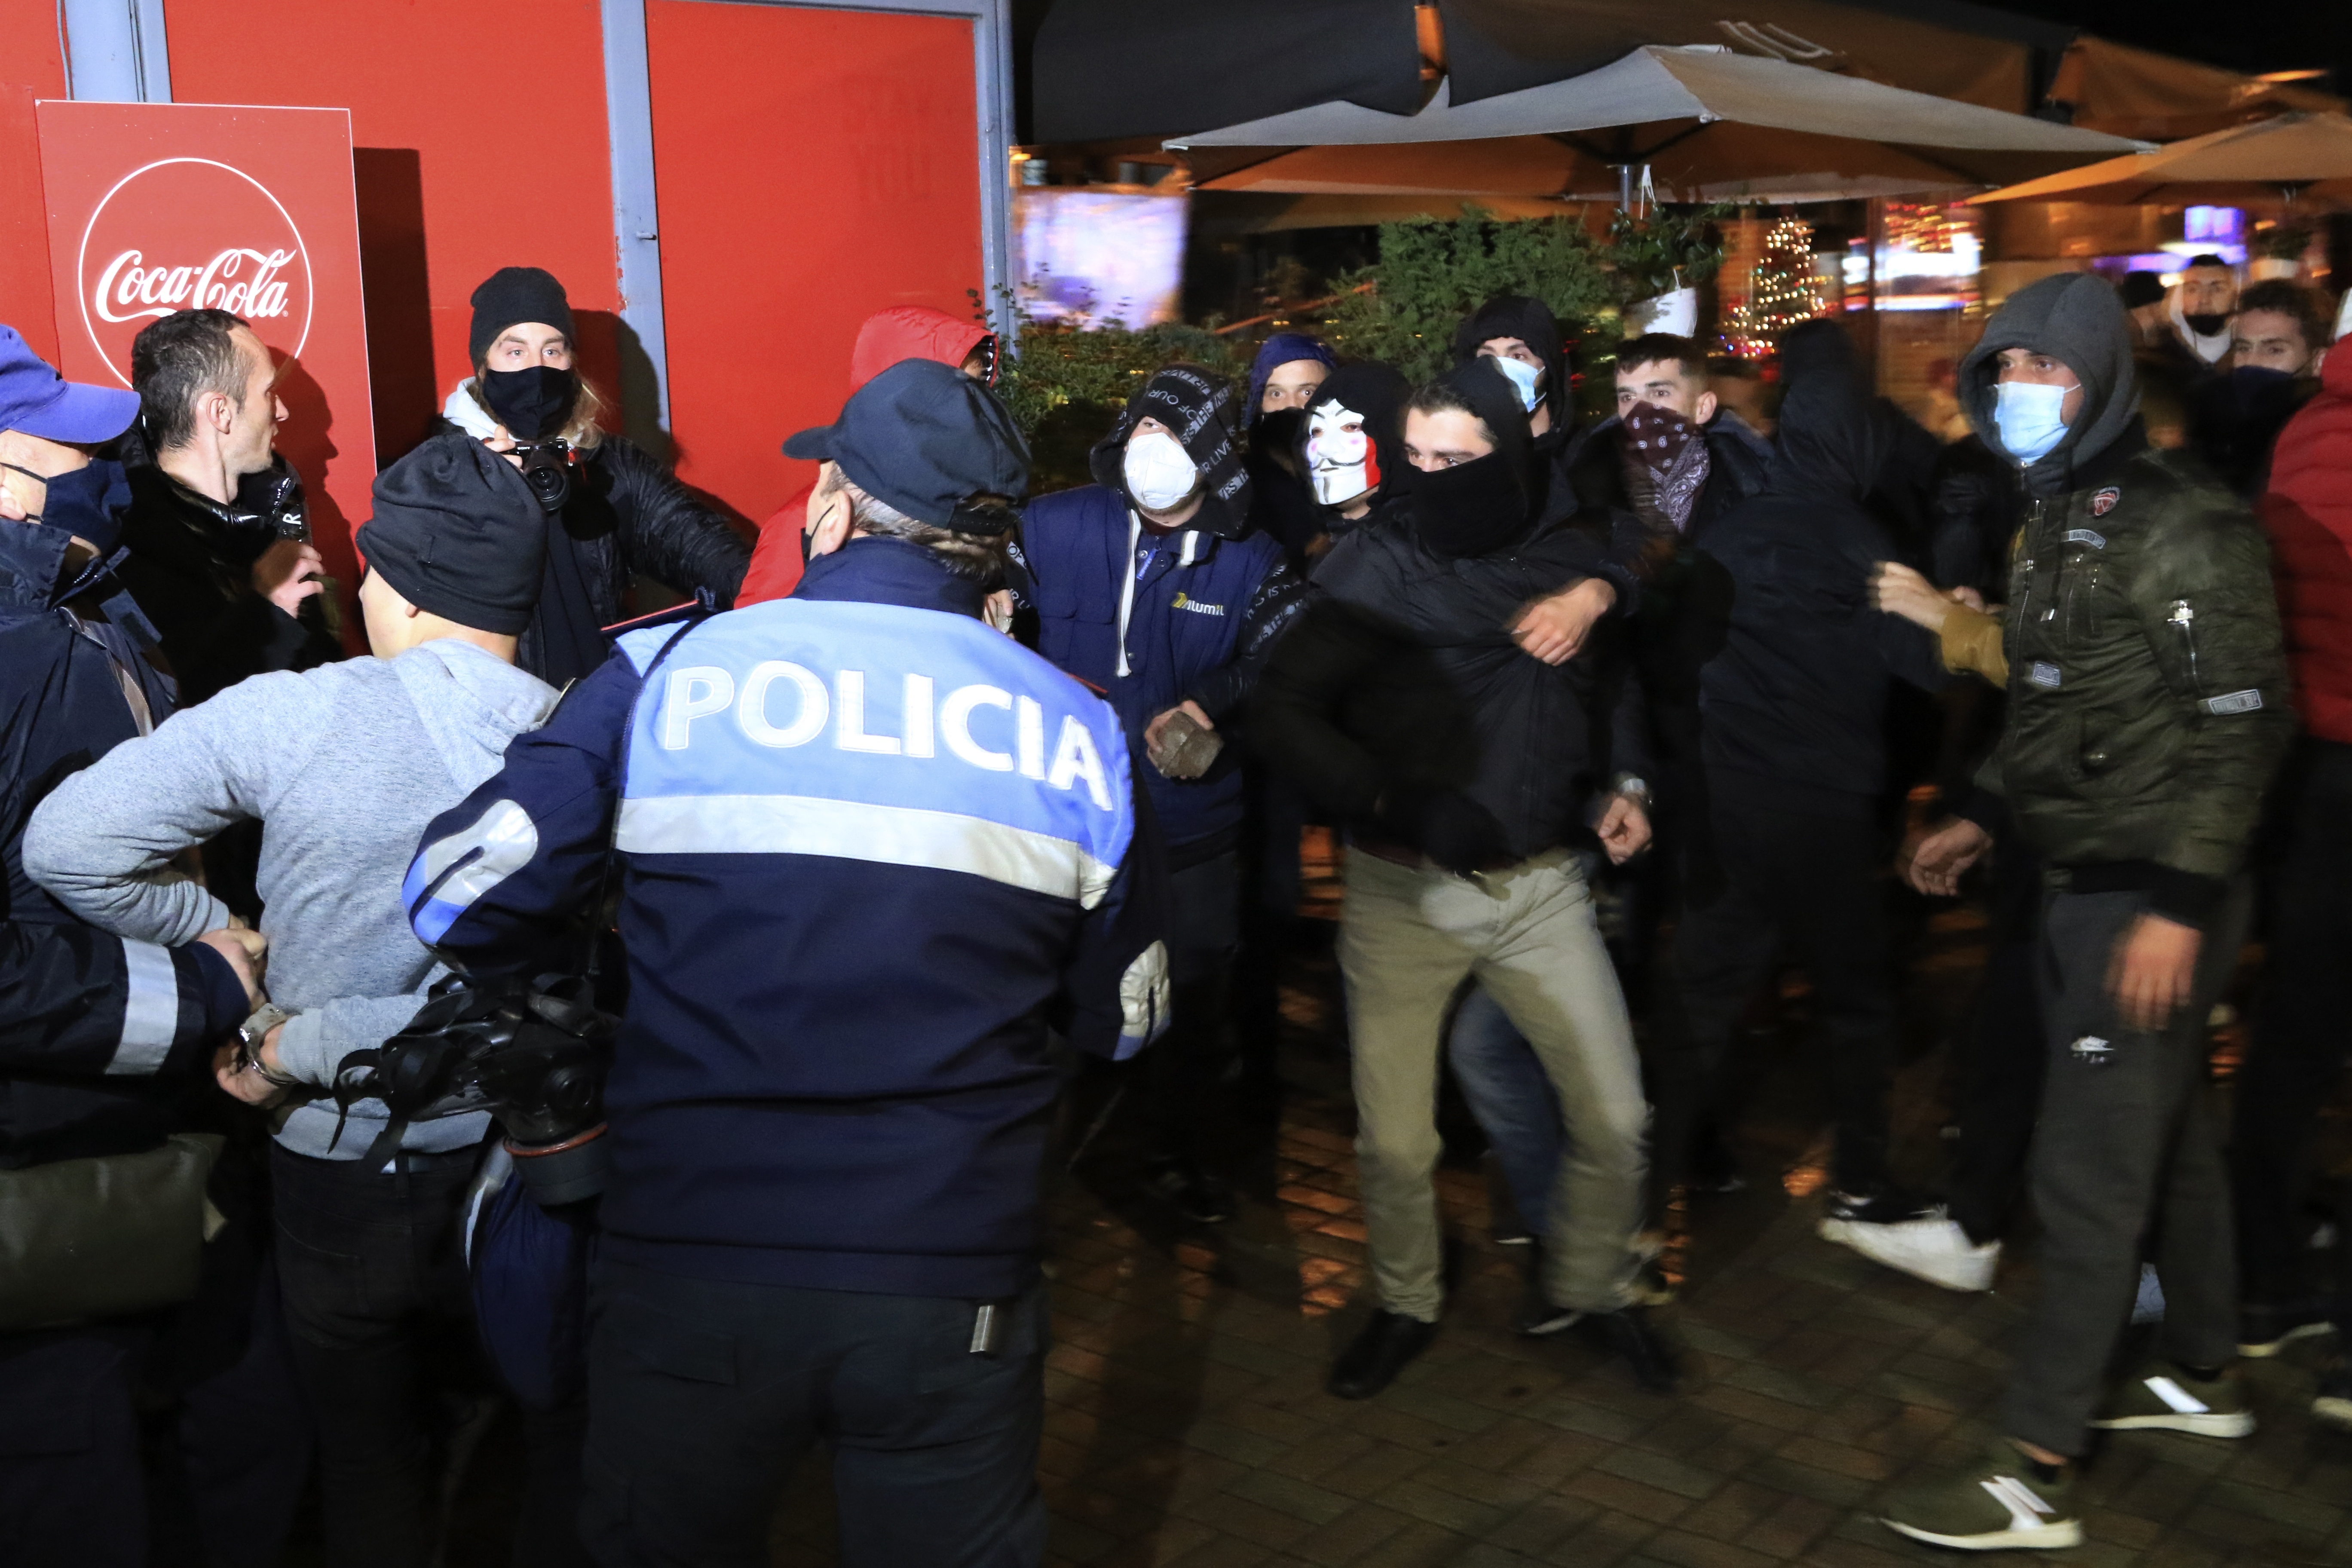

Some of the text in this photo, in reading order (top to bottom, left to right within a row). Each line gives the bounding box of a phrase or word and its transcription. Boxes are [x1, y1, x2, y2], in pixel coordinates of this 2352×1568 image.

[95, 248, 297, 322] Coca-Cola
[1148, 389, 1179, 404] OUR
[665, 660, 1112, 811] POLICIA
